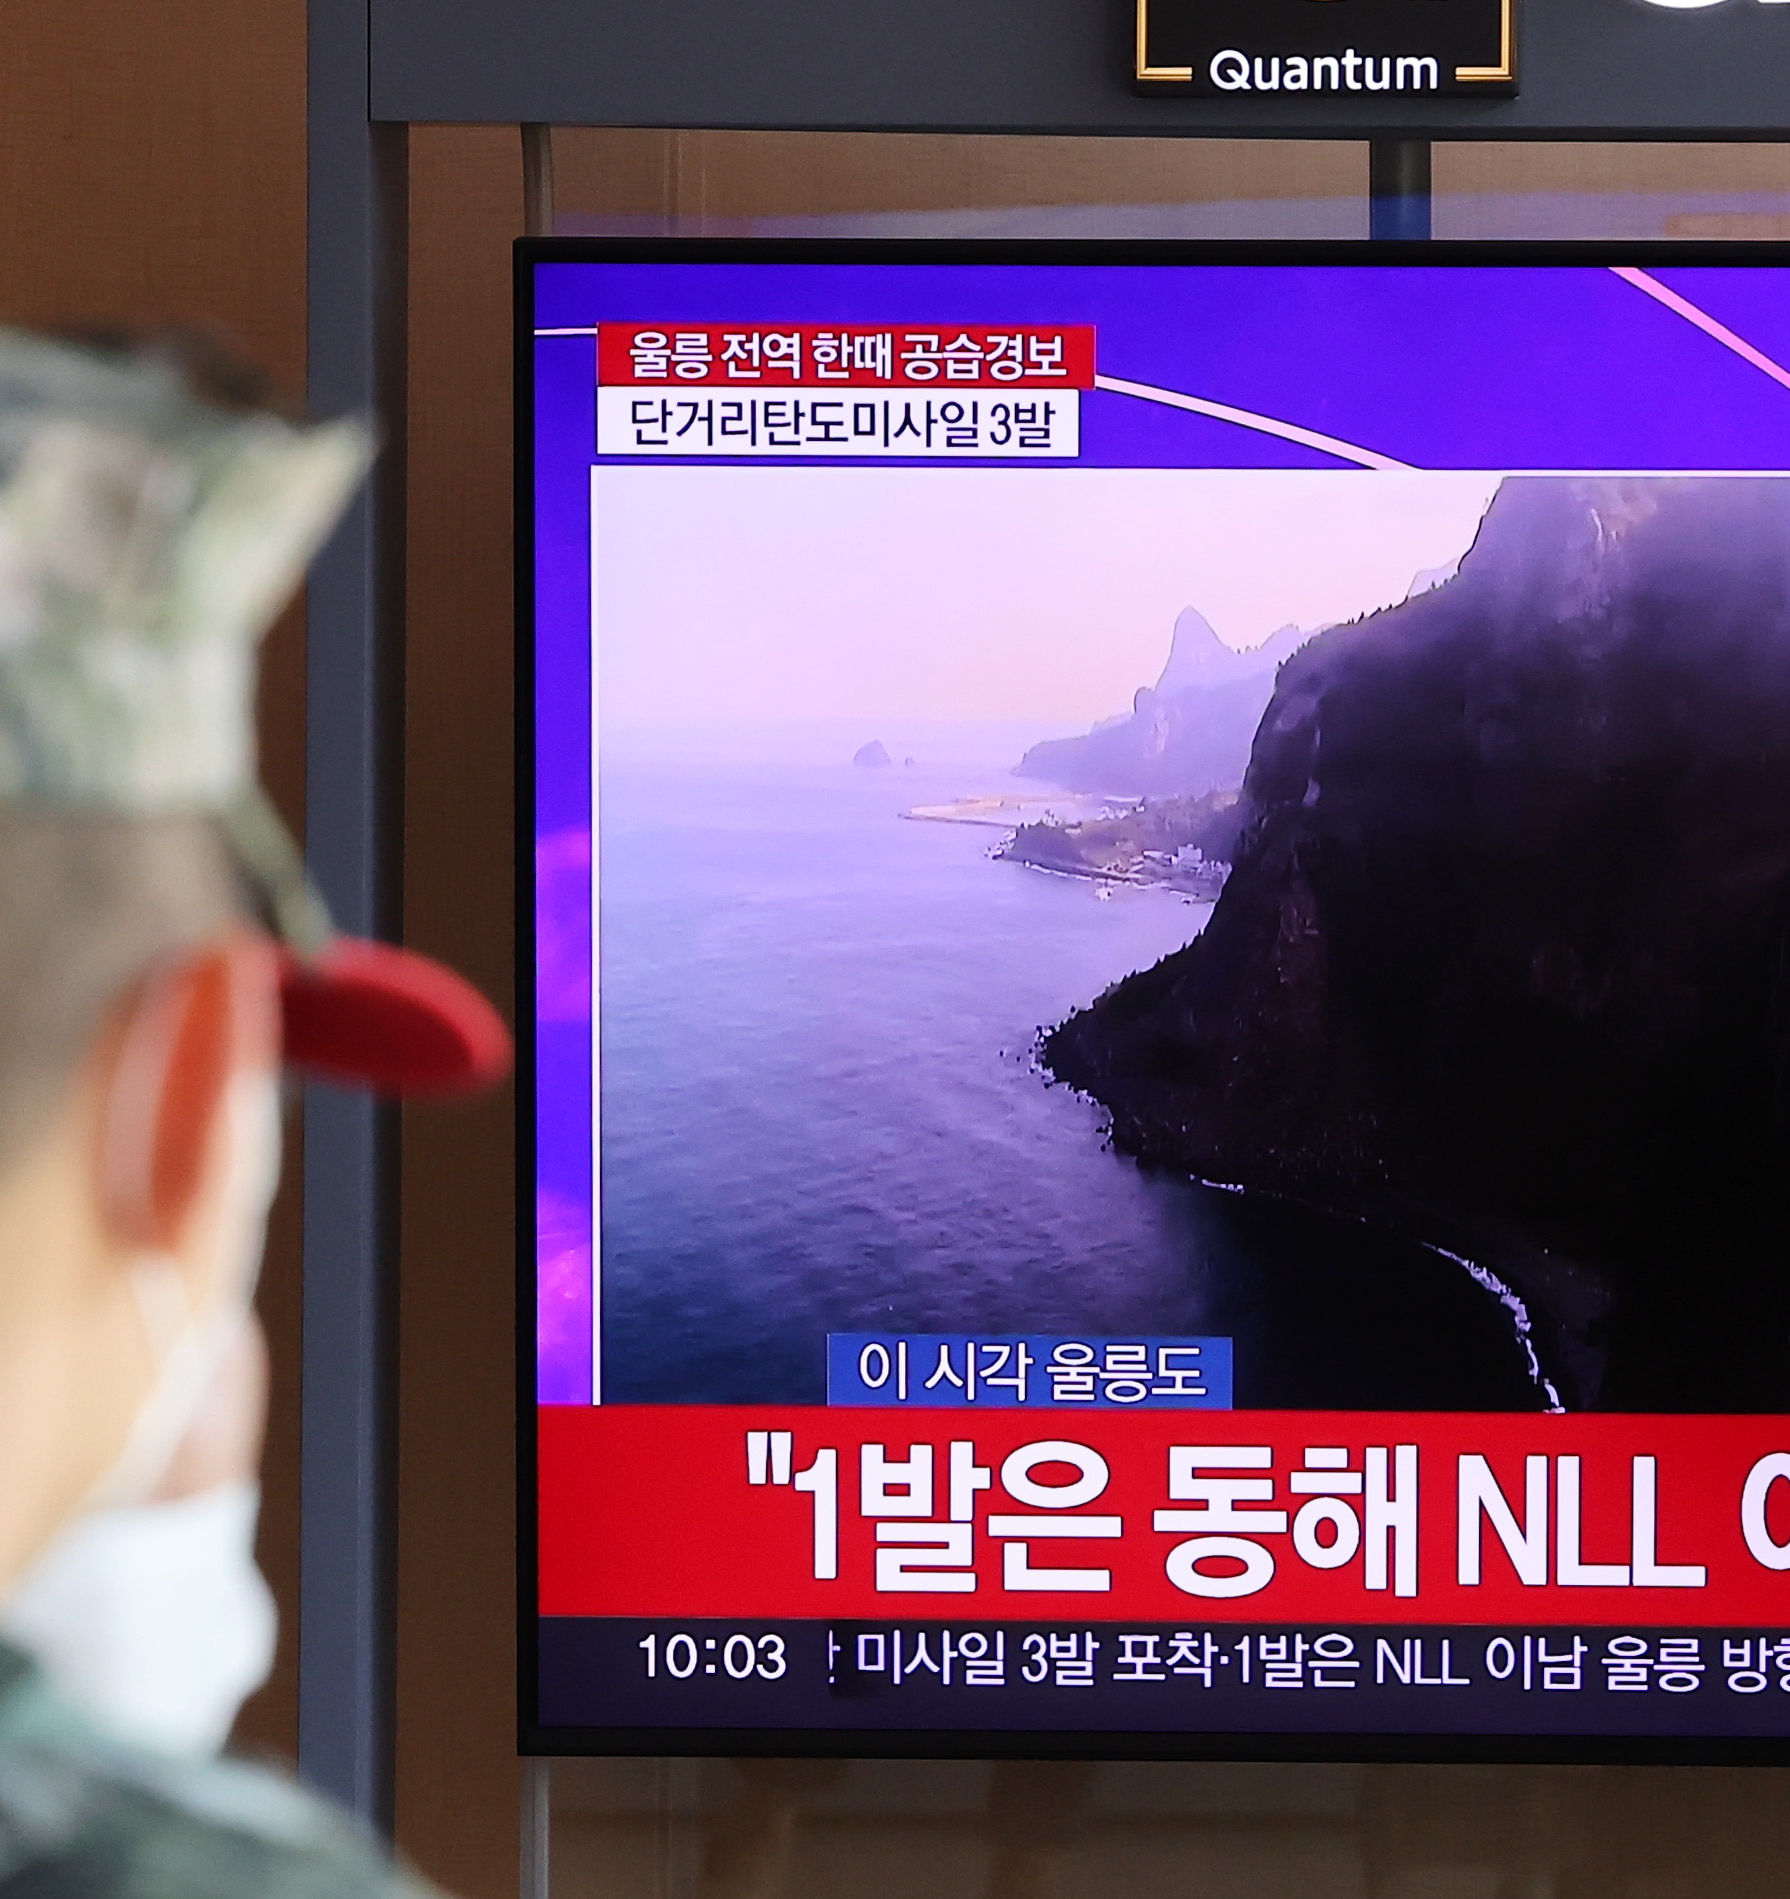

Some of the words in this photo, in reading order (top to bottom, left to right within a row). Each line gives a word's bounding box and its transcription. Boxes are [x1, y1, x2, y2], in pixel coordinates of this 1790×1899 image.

[1209, 47, 1438, 90] Quantum
[628, 331, 712, 379] 울릉
[720, 331, 800, 379] 전역
[811, 331, 892, 380] 한때
[899, 332, 1067, 381] 공습경보
[630, 398, 981, 449] 단거리탄도미사일
[988, 400, 1056, 449] 3발
[859, 1340, 906, 1400] 이
[924, 1341, 1034, 1401] 시각
[1045, 1342, 1206, 1403] 울릉도
[746, 1430, 1122, 1592] "1발은
[1152, 1444, 1417, 1598] 동해
[1457, 1453, 1706, 1587] NLL
[638, 1633, 786, 1680] 10:03
[857, 1628, 1005, 1685] 미사일
[1020, 1630, 1100, 1686] 3발
[1375, 1637, 1470, 1685] NLL
[1485, 1634, 1588, 1690] 이남
[1600, 1634, 1705, 1692] 울릉
